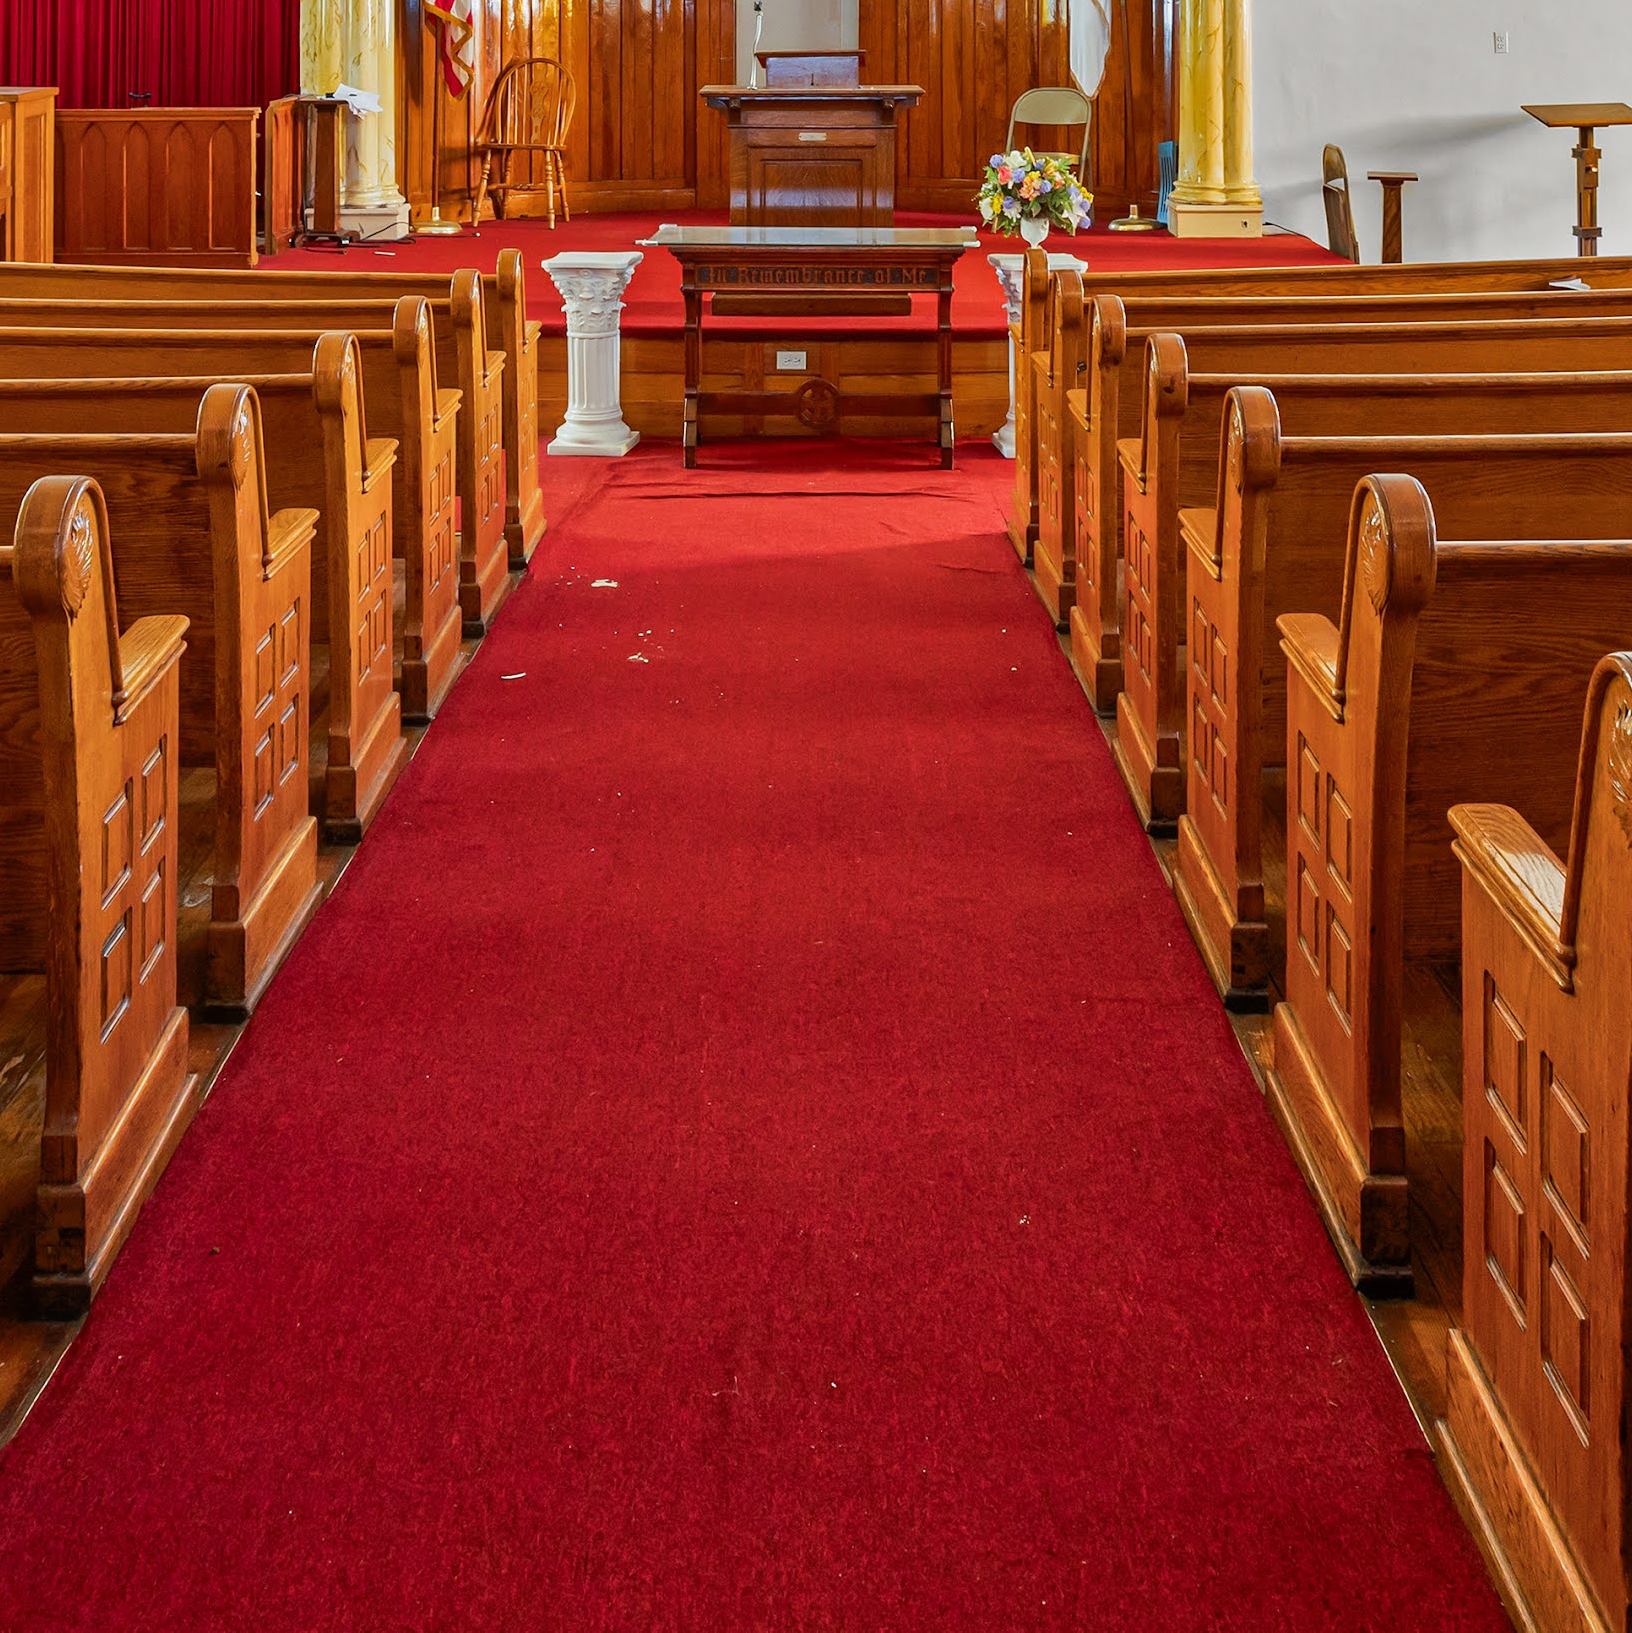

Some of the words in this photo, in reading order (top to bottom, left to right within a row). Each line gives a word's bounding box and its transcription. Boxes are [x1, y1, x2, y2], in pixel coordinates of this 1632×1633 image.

[709, 266, 727, 283] In
[738, 267, 864, 284] Remembrance
[874, 268, 892, 284] of
[902, 268, 927, 284] Me
